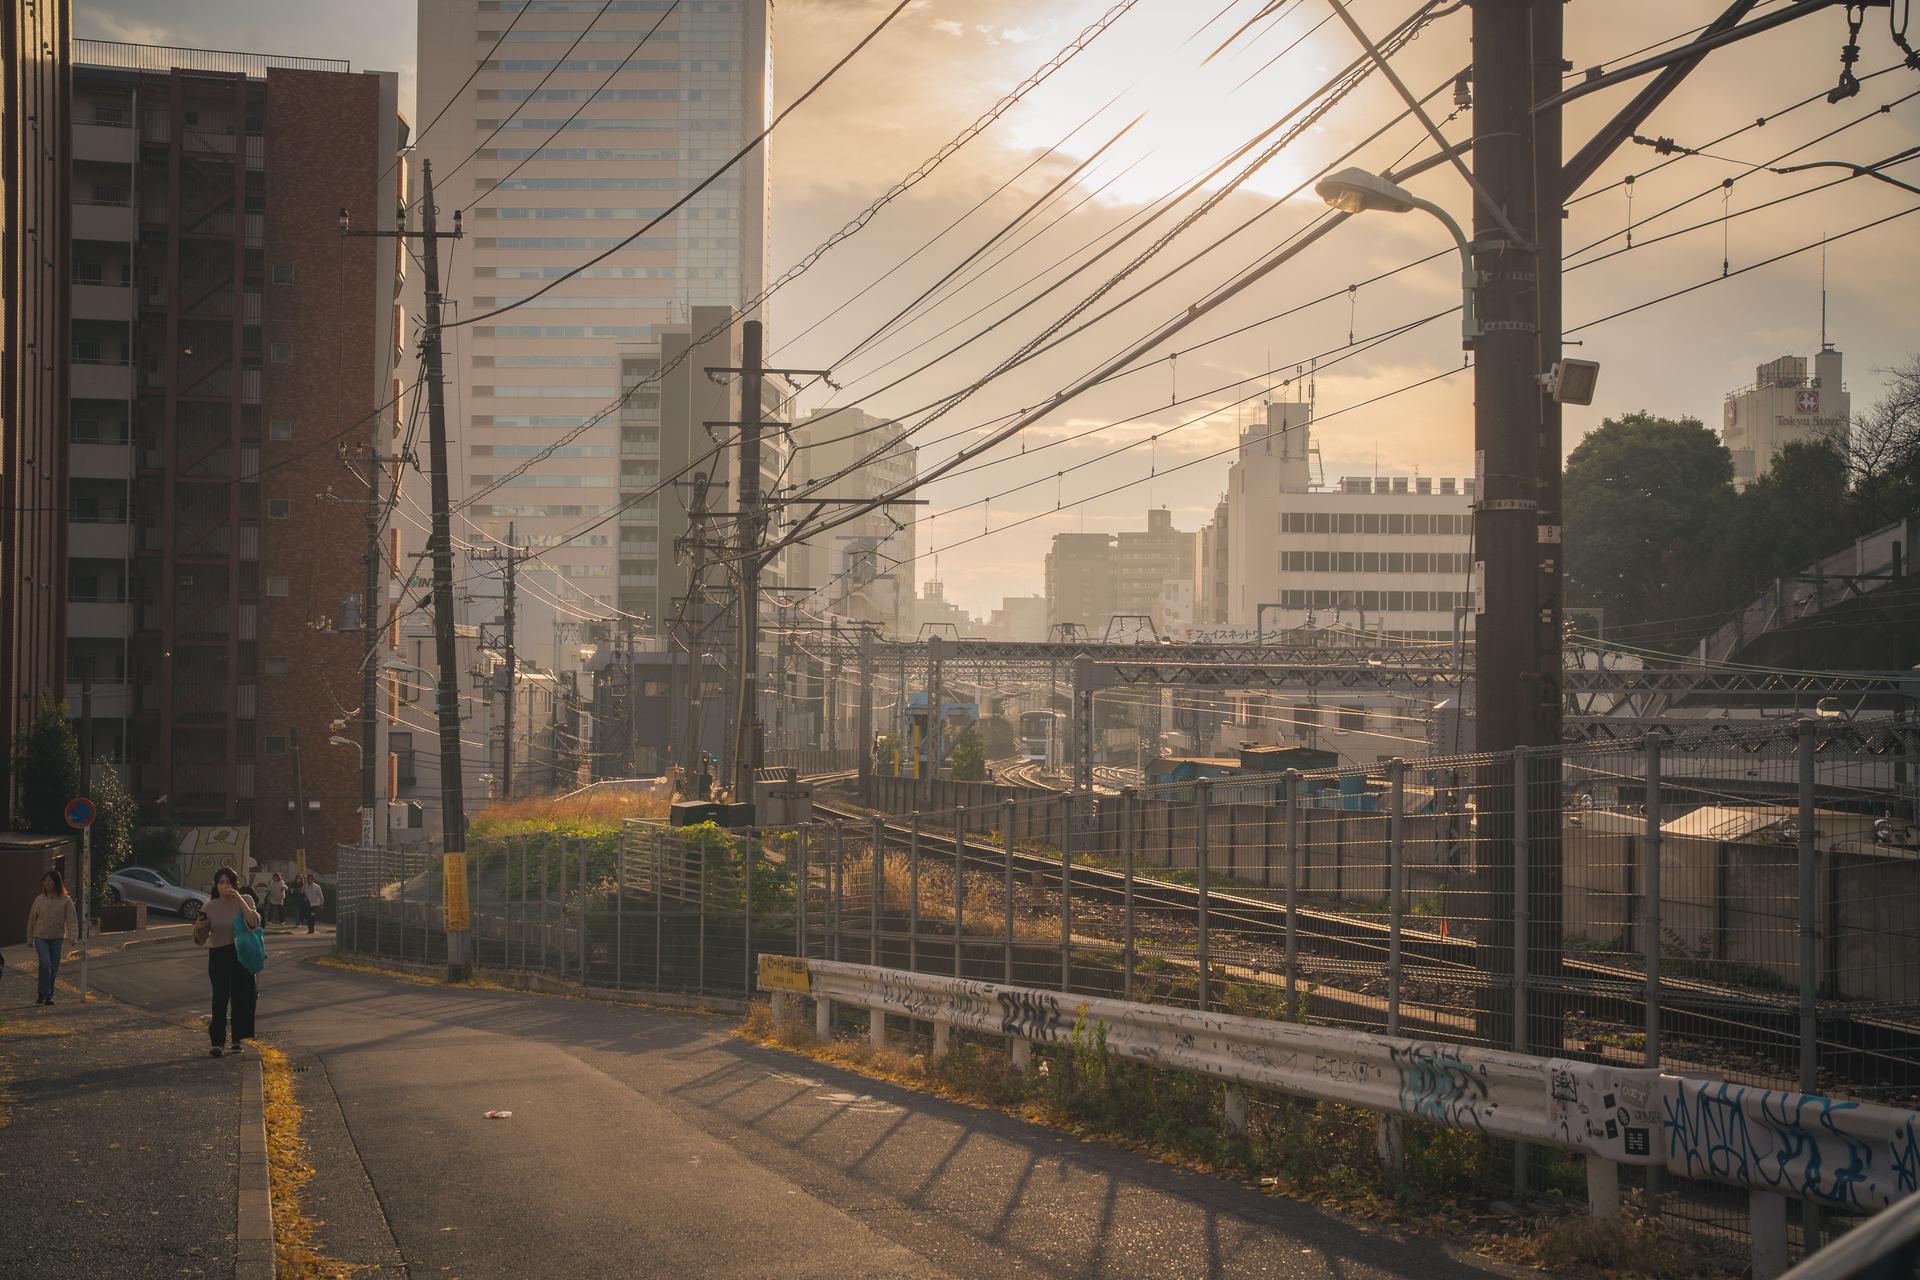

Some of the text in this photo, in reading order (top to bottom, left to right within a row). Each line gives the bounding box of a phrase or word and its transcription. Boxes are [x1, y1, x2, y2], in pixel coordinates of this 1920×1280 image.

[1776, 415, 1841, 427] Tokyu Store
[1547, 526, 1552, 537] 8
